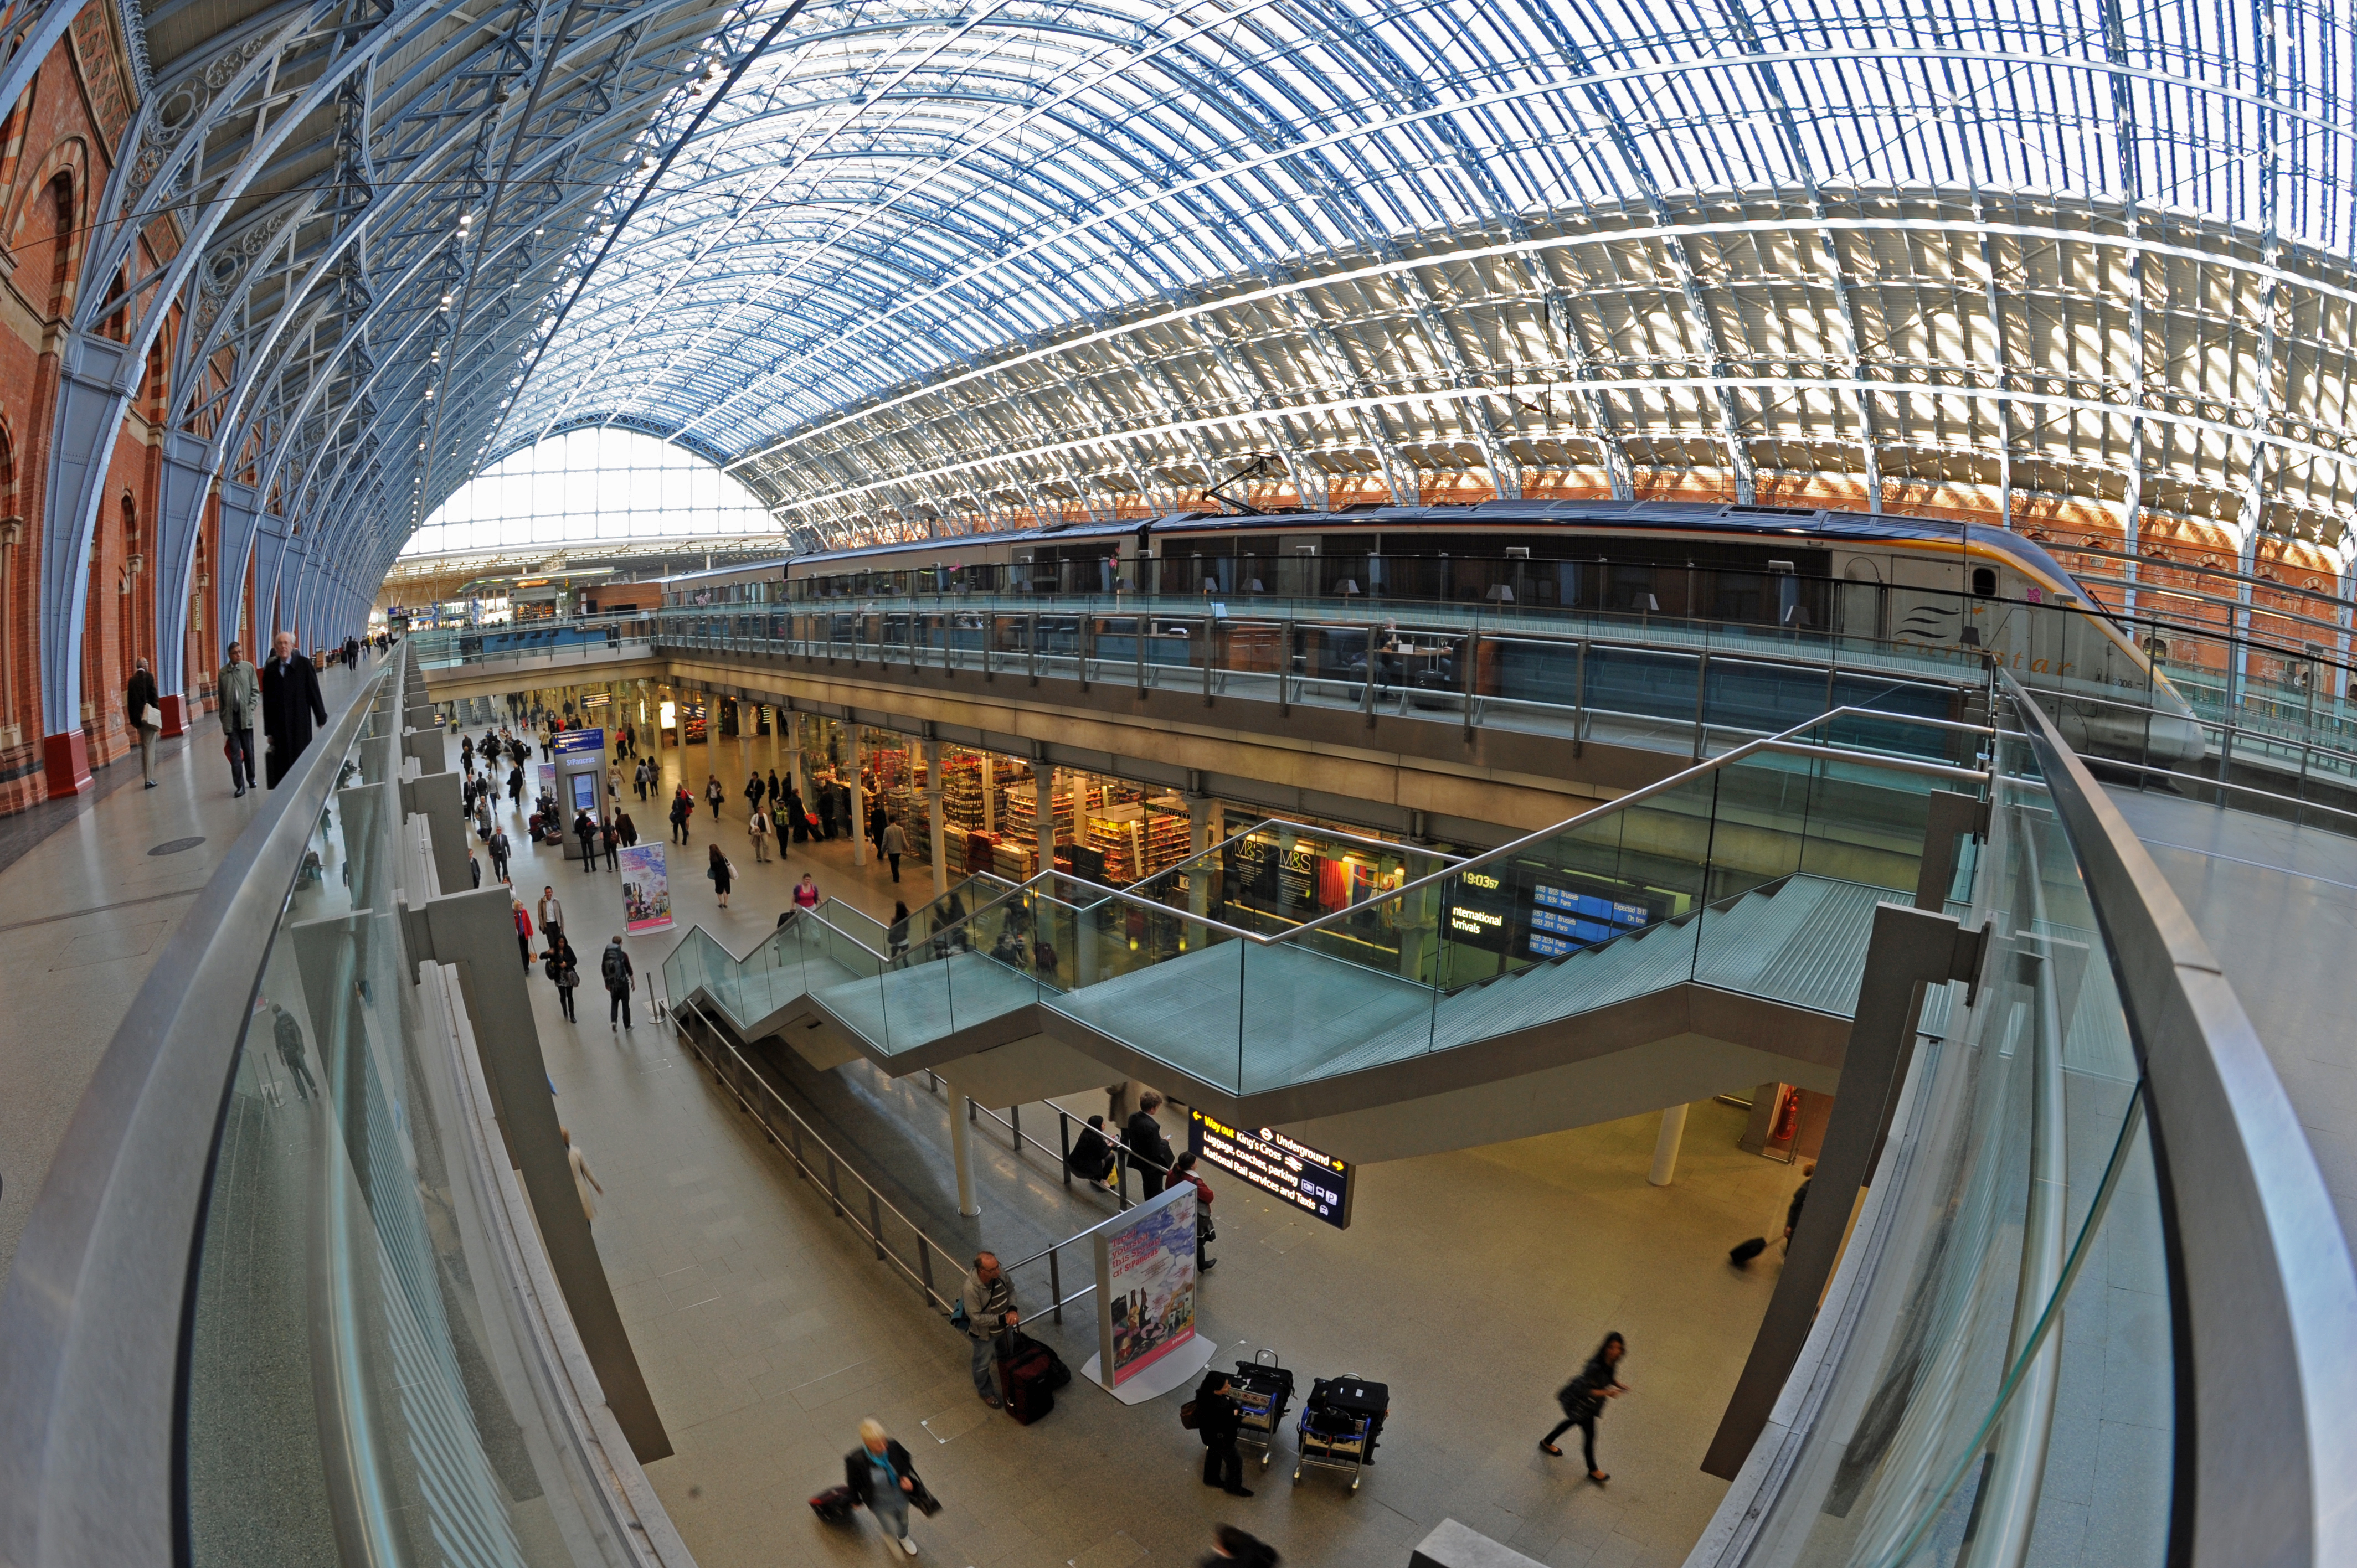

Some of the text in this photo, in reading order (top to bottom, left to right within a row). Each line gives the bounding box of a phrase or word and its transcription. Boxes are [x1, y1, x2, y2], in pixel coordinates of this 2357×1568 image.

[2113, 678, 2133, 688] 3006
[1174, 810, 1191, 820] FOOD
[1234, 840, 1264, 859] M&S
[1280, 849, 1311, 871] M&S
[1560, 899, 1571, 907] Paris
[1561, 890, 1579, 901] Brussels
[1453, 907, 1502, 926] nternational
[1614, 902, 1635, 914] Expected
[1558, 915, 1576, 925] Brussels
[1555, 939, 1566, 948] Paris
[1205, 1116, 1282, 1161] Way out King's Cross
[1203, 1131, 1298, 1187] Luggage, coaches, parking
[1276, 1134, 1329, 1166] Underground
[1203, 1146, 1315, 1210] National Rail services and Taxis
[1111, 1229, 1137, 1247] Treat
[1111, 1232, 1149, 1260] yourself
[1113, 1237, 1161, 1268] this Spring
[1113, 1267, 1123, 1278] at
